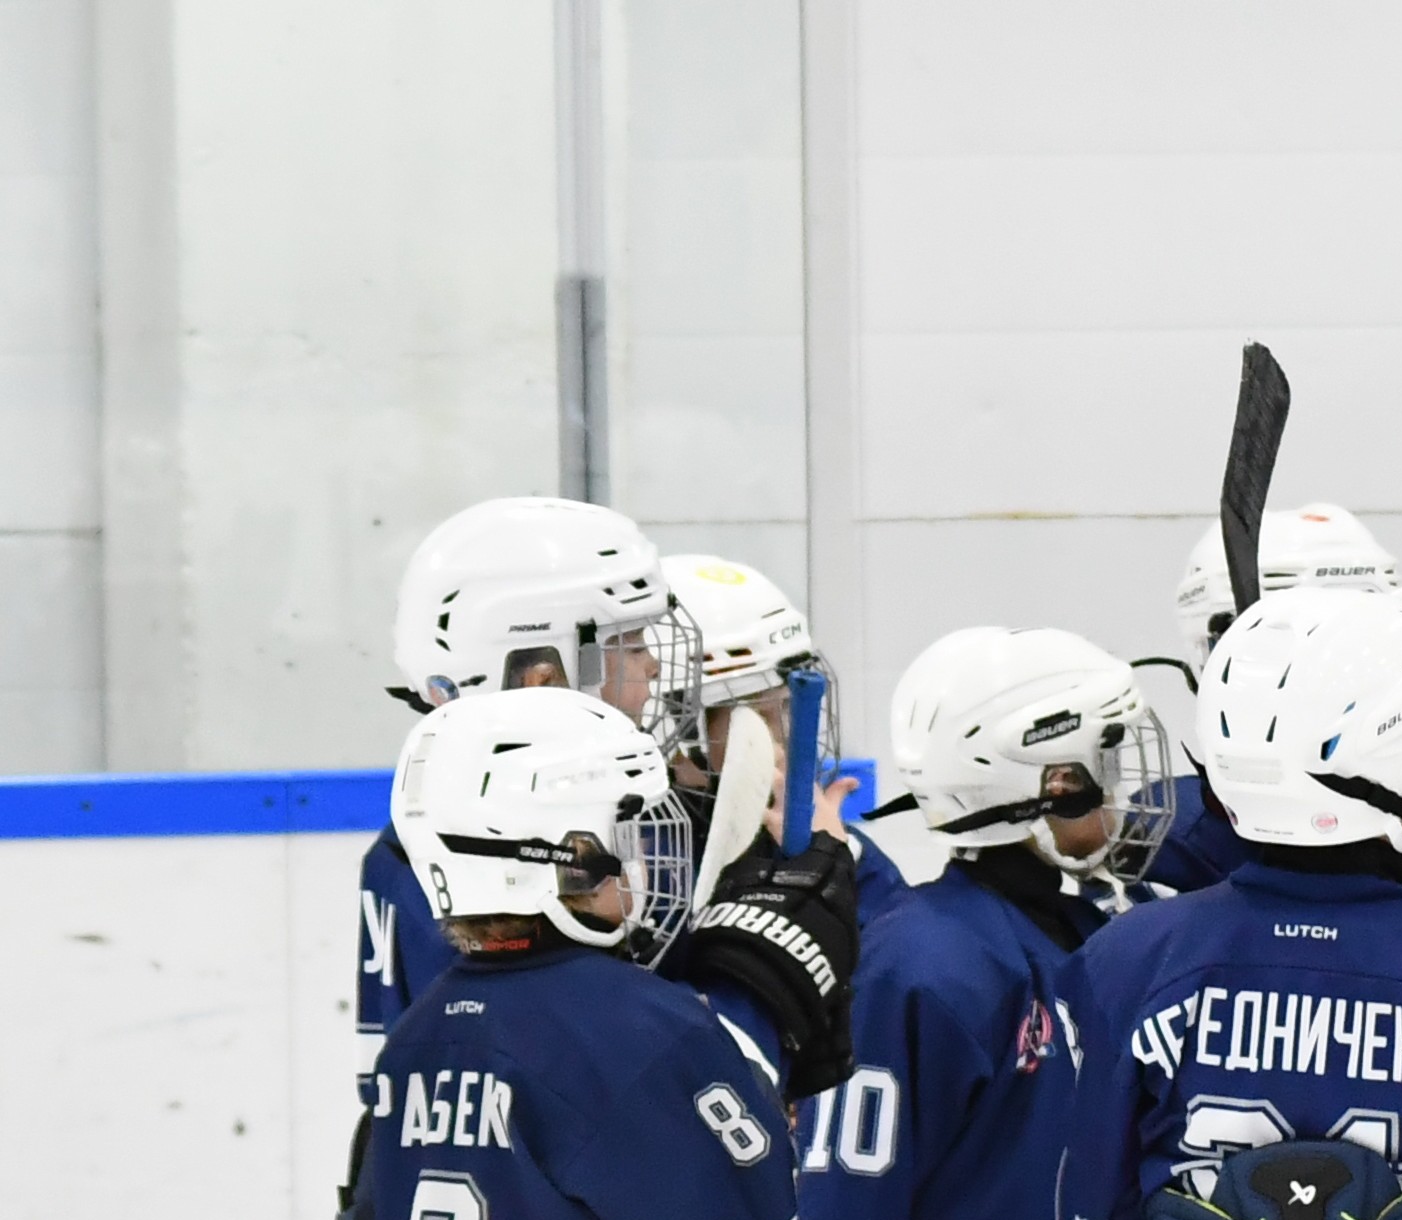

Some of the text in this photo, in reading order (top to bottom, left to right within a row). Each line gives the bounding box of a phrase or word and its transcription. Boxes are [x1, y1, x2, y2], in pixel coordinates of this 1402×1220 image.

[1316, 566, 1376, 577] BAUER
[429, 863, 453, 915] 8
[1274, 923, 1338, 941] LUTCH
[445, 1000, 485, 1015] LUTCH
[692, 1081, 772, 1168] 8
[800, 1064, 900, 1177] 10
